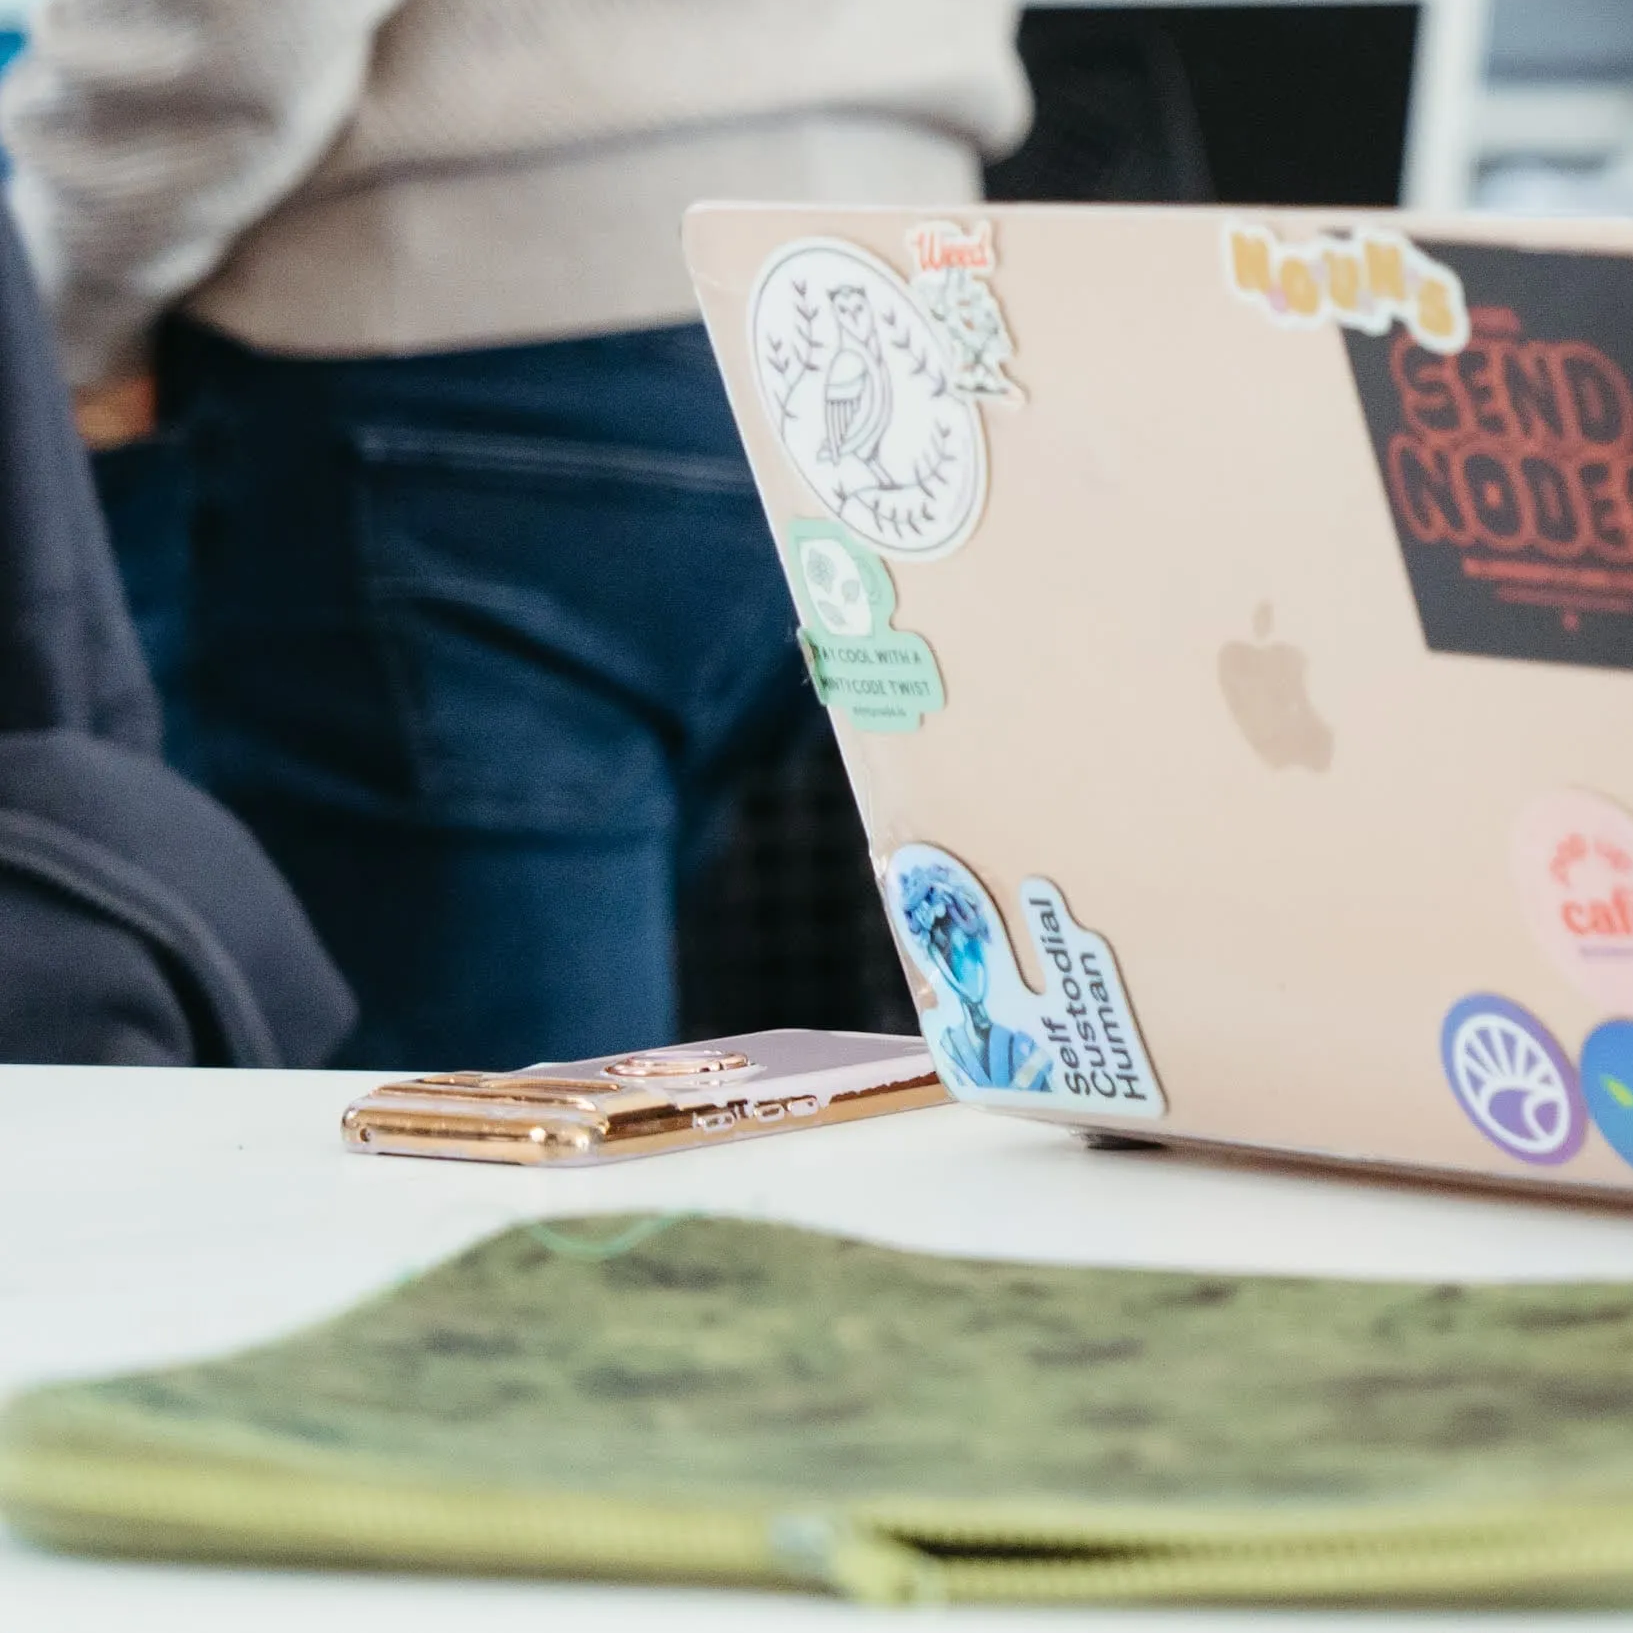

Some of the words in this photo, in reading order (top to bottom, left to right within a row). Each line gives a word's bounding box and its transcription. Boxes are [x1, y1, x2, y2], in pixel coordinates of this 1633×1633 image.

[874, 648, 911, 665] WITH
[888, 679, 931, 697] TWIST
[1028, 897, 1118, 1100] Custodial
[1080, 951, 1148, 1101] Human
[1041, 1016, 1091, 1096] Self
